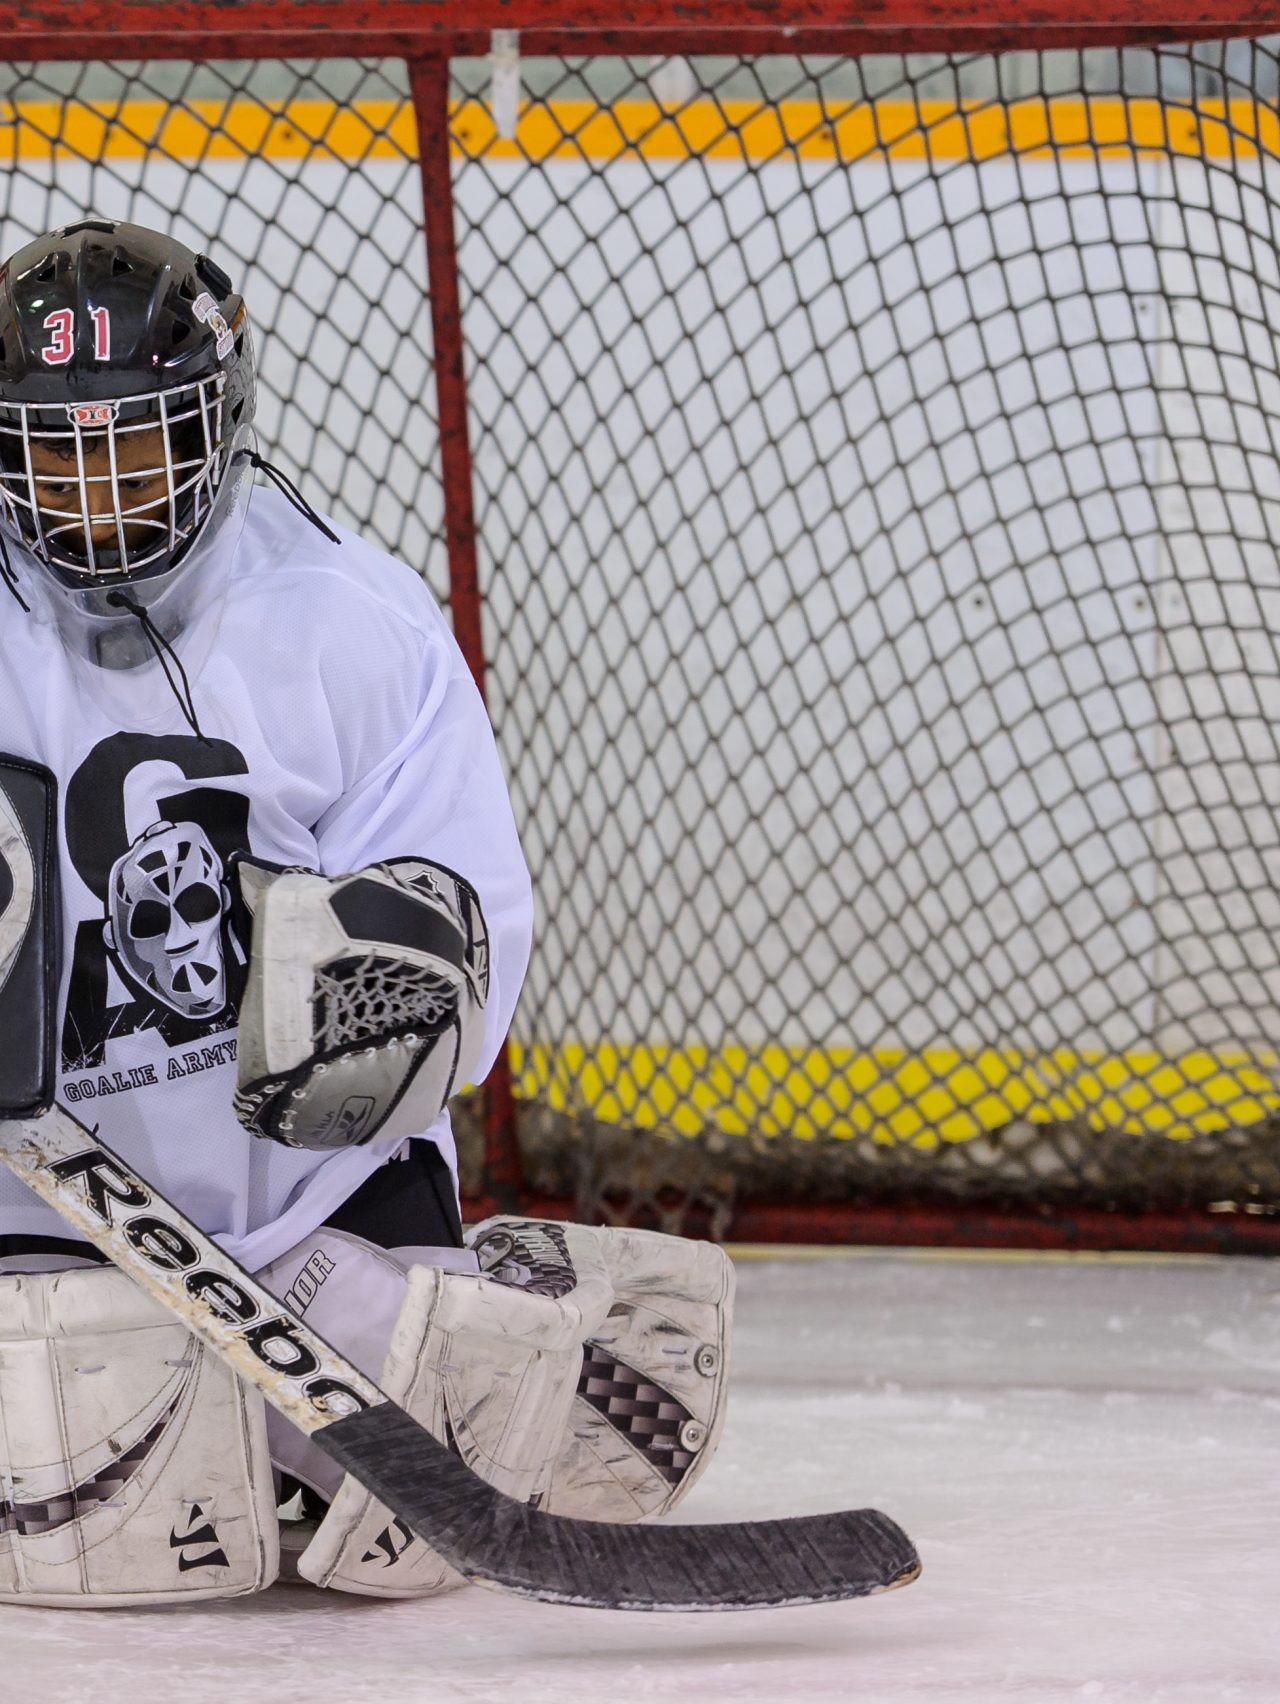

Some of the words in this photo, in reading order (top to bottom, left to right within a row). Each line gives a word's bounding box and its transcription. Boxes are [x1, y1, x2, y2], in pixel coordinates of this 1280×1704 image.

[41, 306, 111, 365] 31
[63, 1063, 159, 1103] GOALIE
[167, 1038, 238, 1080] ARMY
